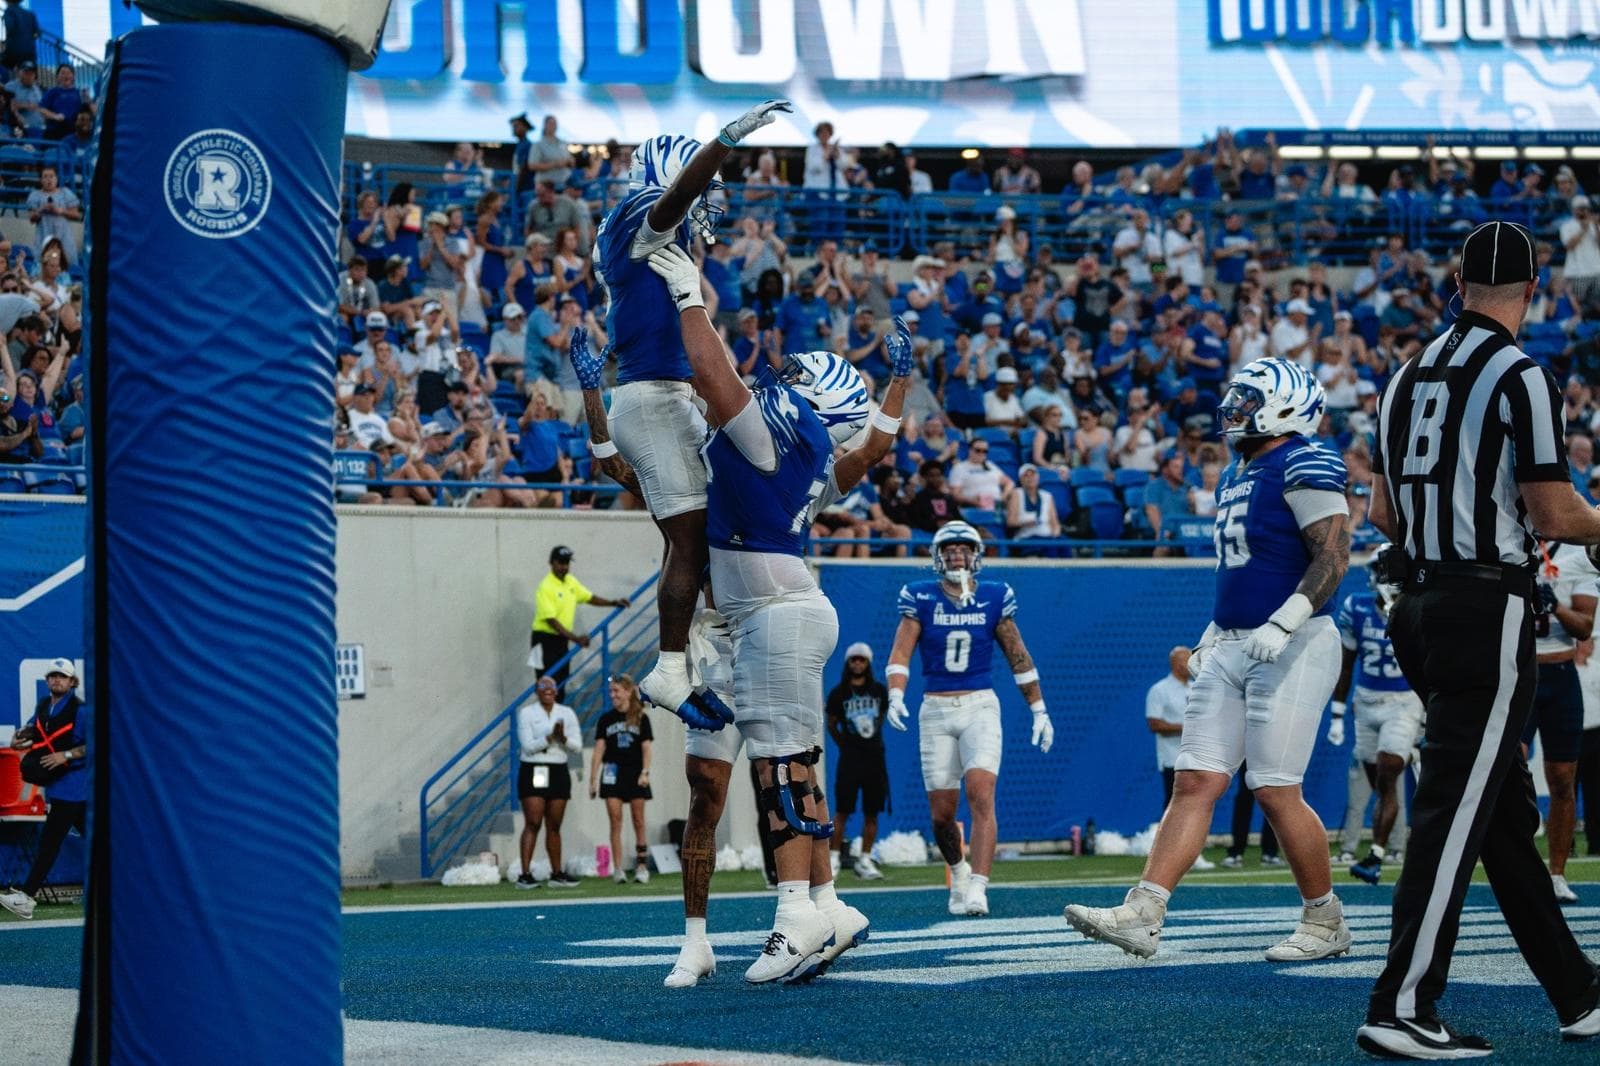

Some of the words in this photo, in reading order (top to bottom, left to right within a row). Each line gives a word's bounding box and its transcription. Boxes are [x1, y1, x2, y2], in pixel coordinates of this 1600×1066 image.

[188, 138, 242, 158] ATHLETIC
[242, 150, 263, 205] COMPANY
[195, 155, 241, 211] R
[186, 209, 247, 229] ROGERS
[1402, 381, 1450, 476] B
[1213, 501, 1252, 572] 55
[933, 613, 986, 625] MEMPHIS
[945, 631, 971, 672] 0
